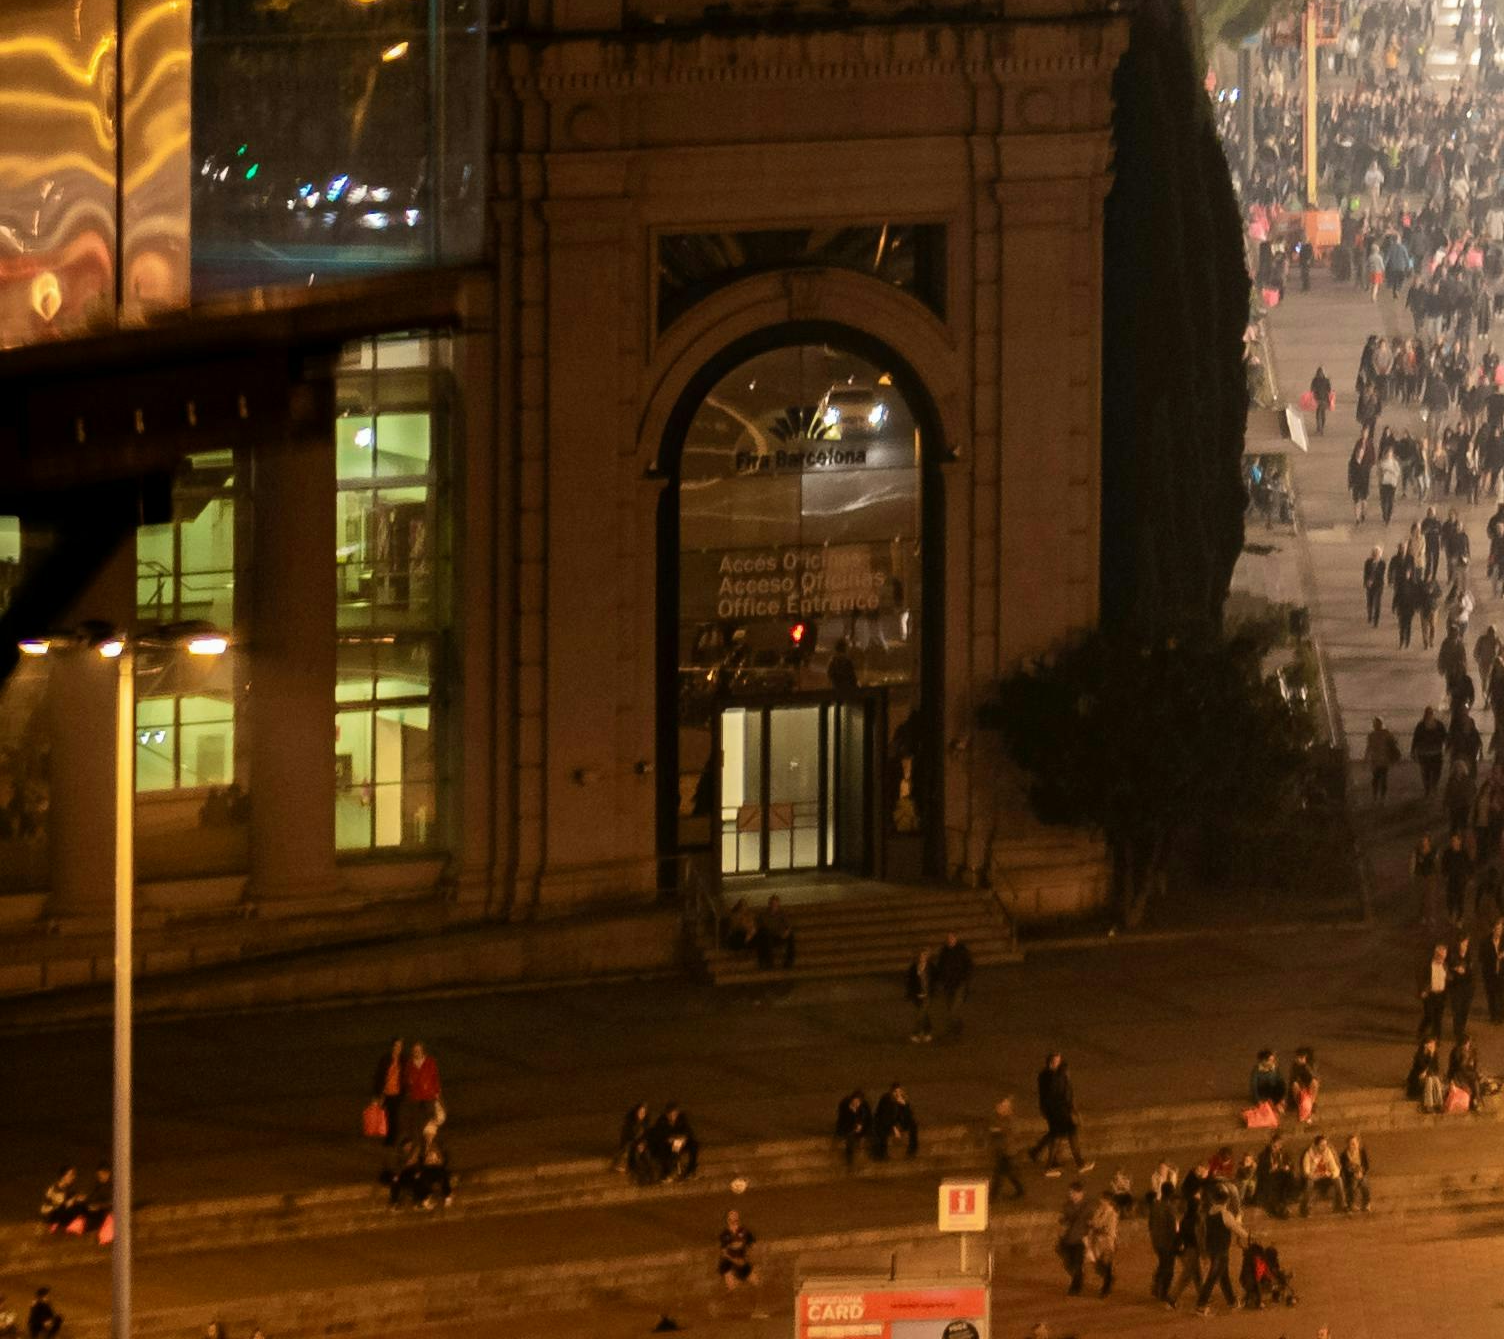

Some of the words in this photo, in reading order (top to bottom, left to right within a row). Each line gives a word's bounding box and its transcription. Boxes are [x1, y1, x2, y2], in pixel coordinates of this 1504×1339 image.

[775, 447, 867, 467] Barcelona
[719, 576, 795, 596] Acceso
[717, 598, 781, 619] Office
[807, 1305, 865, 1321] CARD
